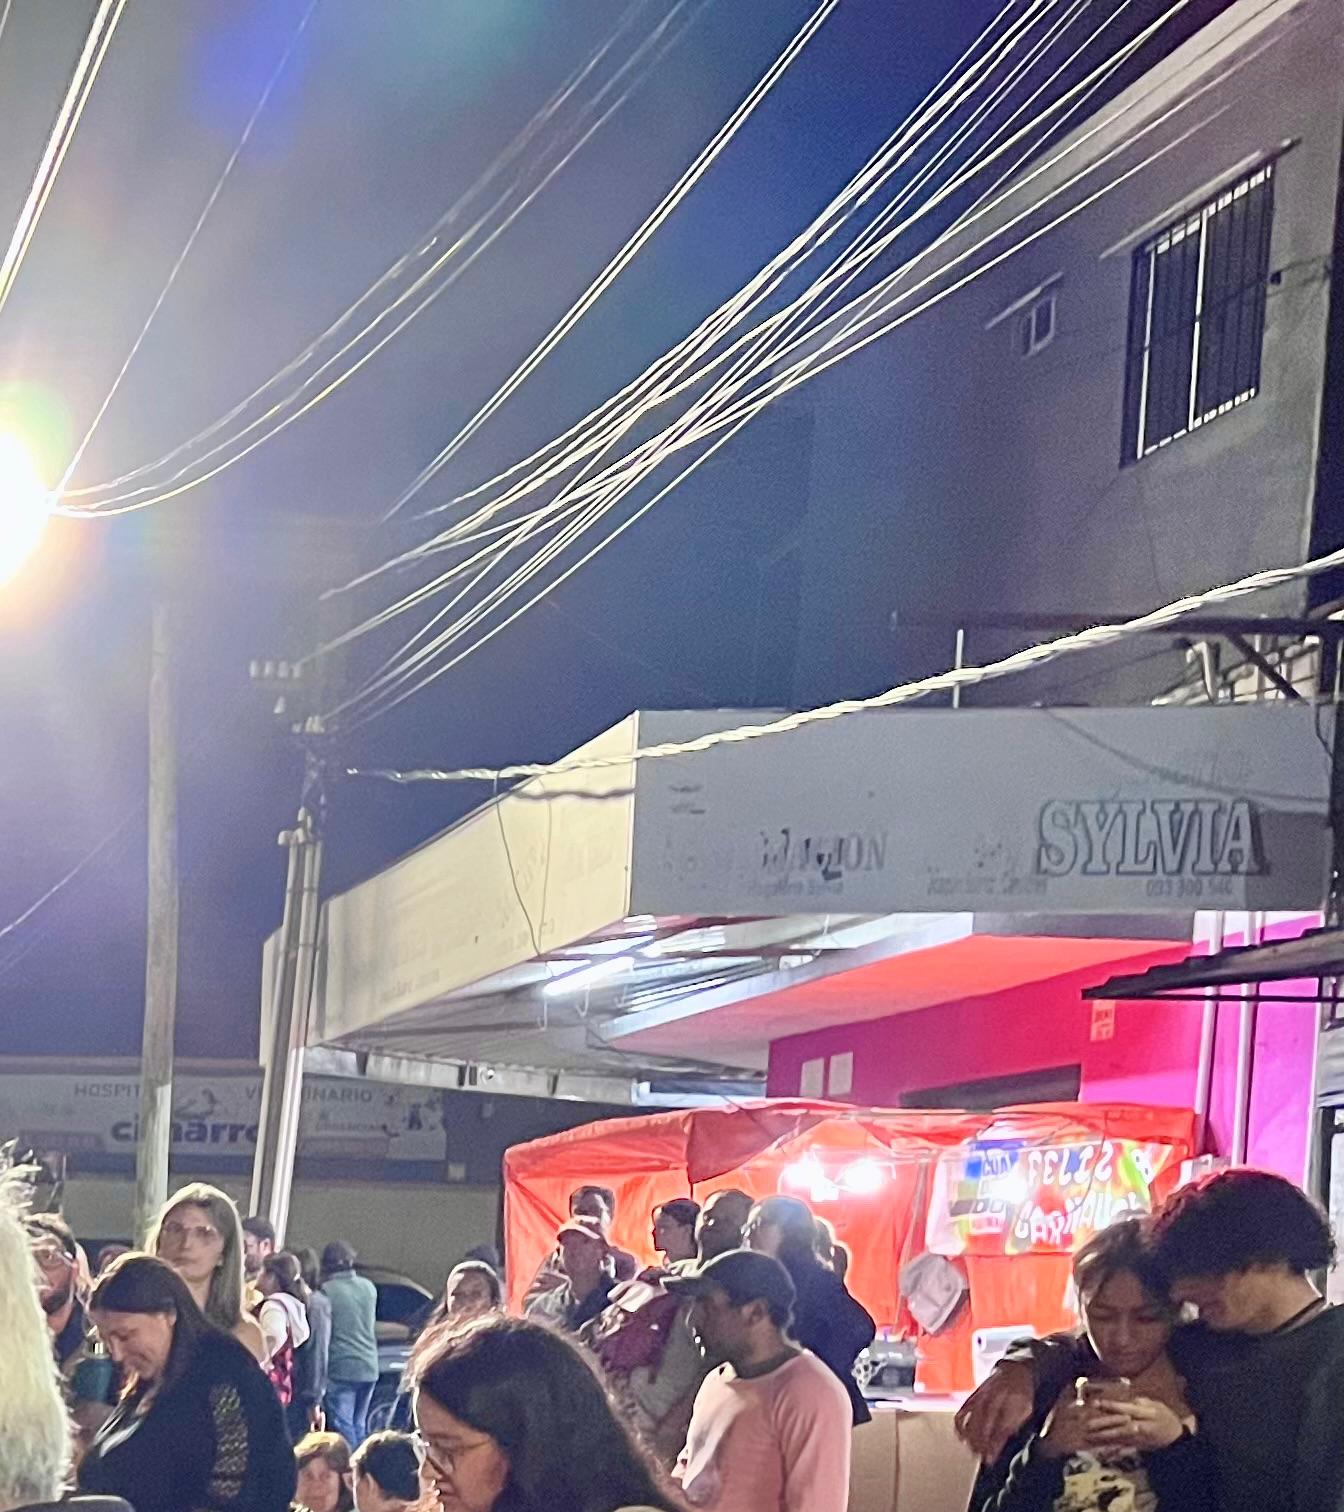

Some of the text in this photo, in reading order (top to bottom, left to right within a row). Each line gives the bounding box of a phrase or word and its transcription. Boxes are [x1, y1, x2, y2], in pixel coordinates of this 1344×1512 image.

[1036, 798, 1268, 877] SYLVIA
[74, 1083, 141, 1098] HOSPIT
[1027, 1140, 1115, 1187] FELIZ
